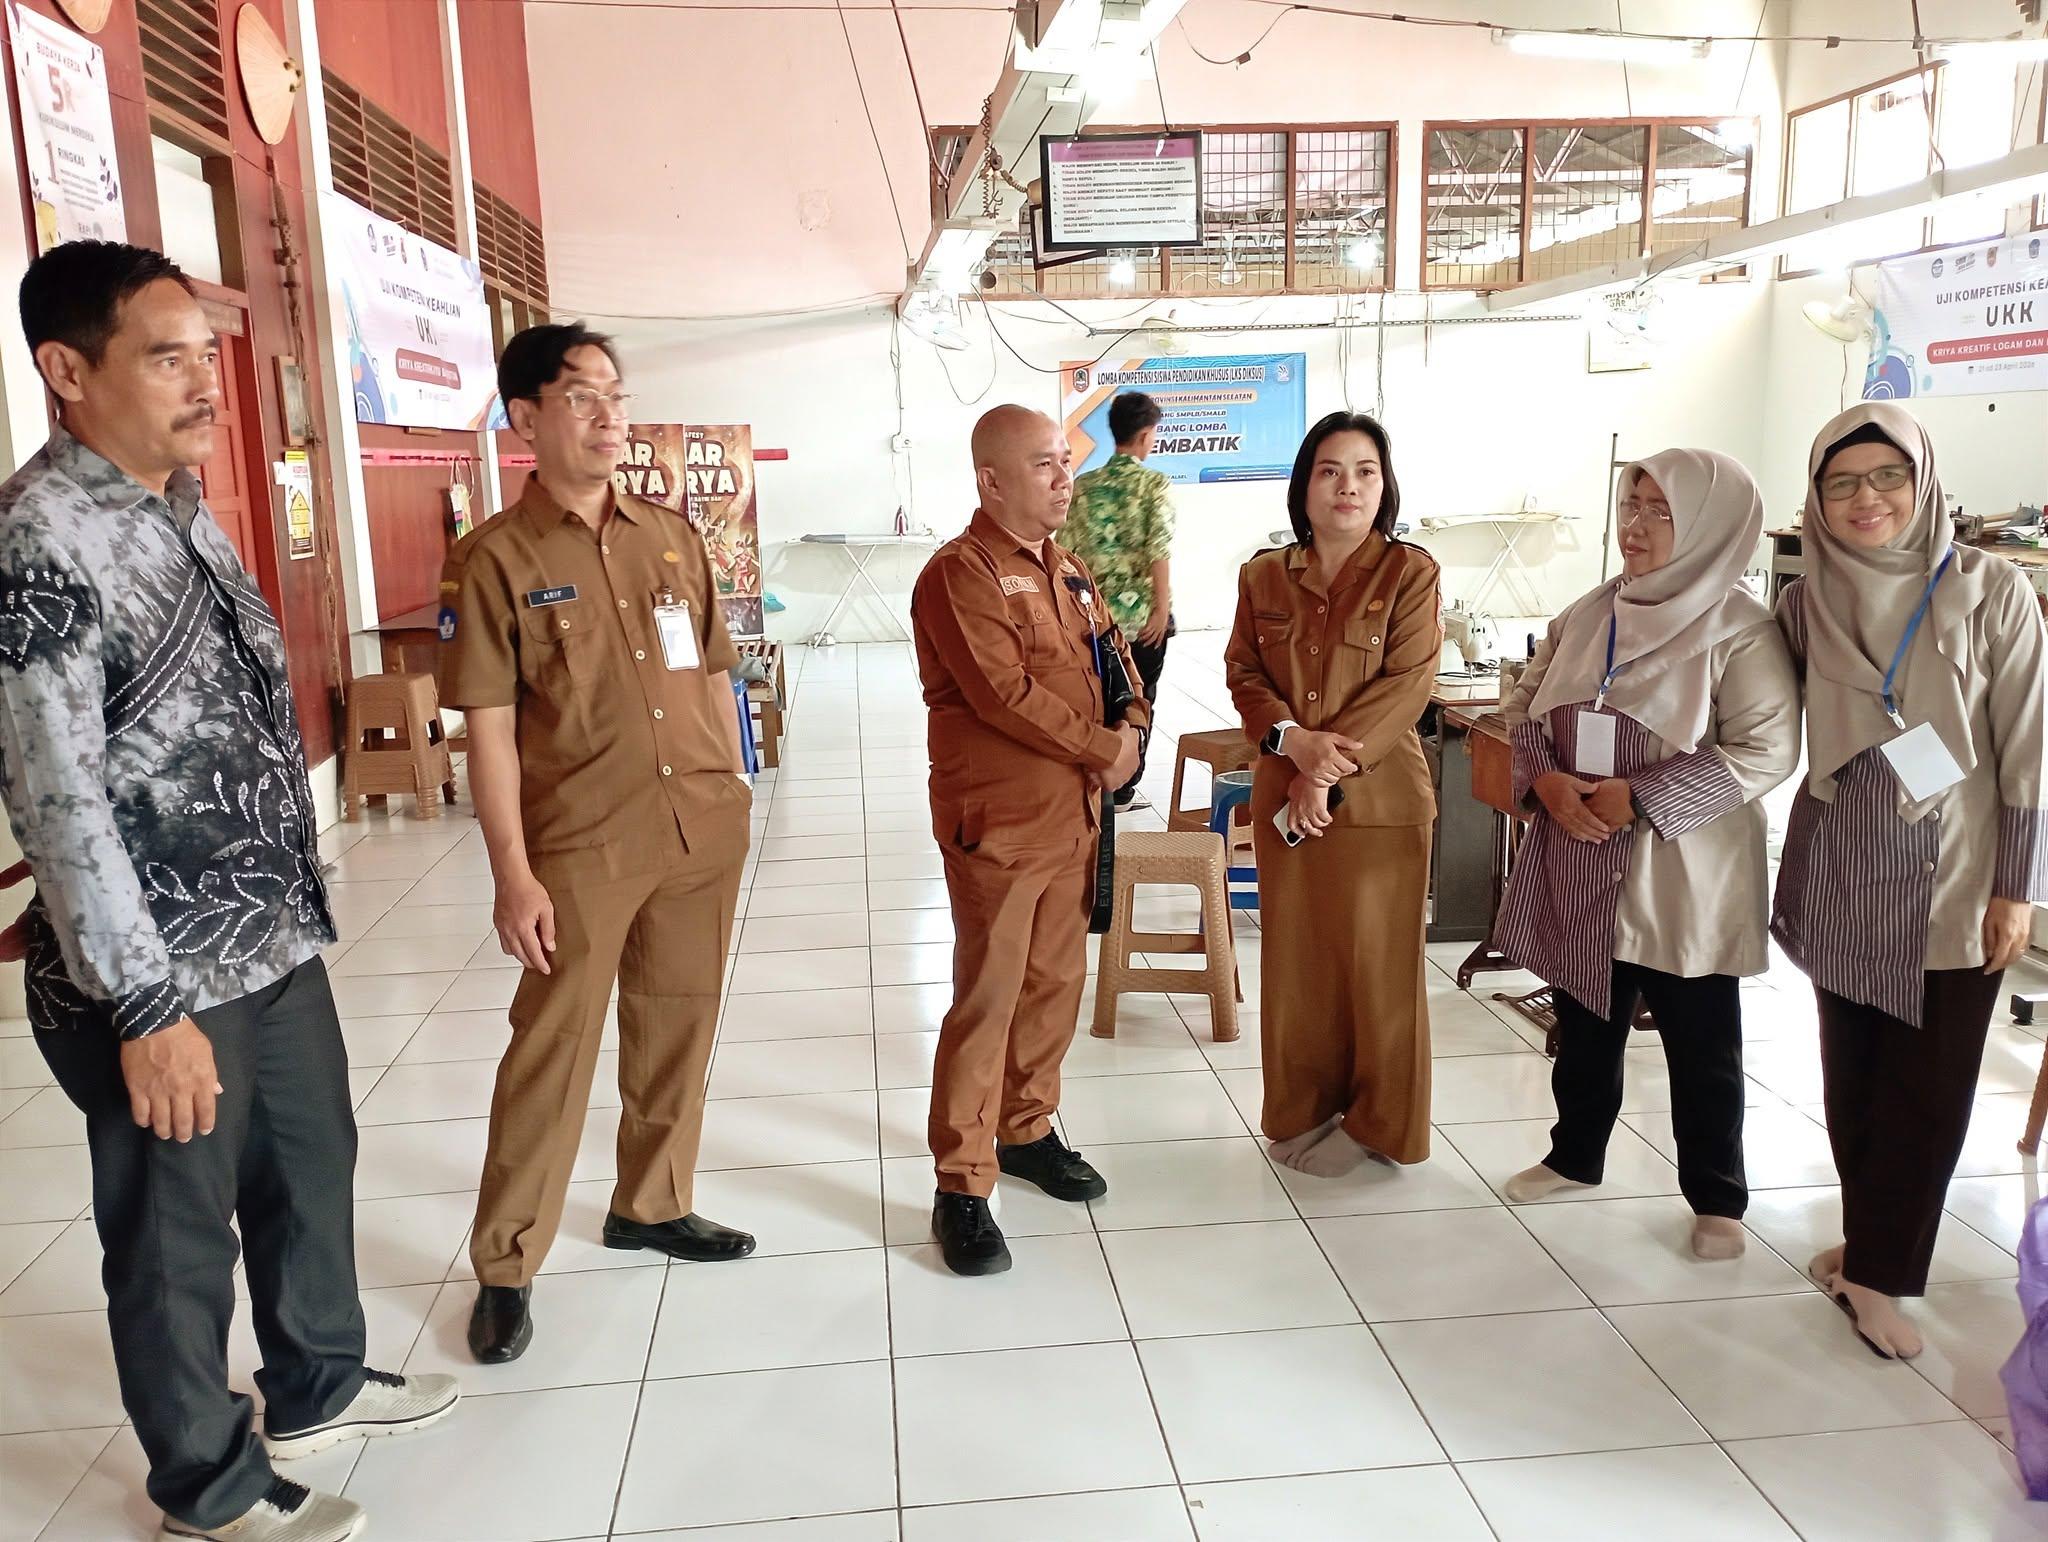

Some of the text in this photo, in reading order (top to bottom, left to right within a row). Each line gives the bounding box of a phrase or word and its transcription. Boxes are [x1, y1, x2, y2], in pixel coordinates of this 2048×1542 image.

[36, 41, 61, 62] BUDAYA
[1936, 292, 1952, 305] UJI
[1955, 281, 2026, 303] KOMPETENSI
[426, 296, 461, 319] KEAHLIAN
[1986, 300, 2034, 328] UKK
[1932, 338, 2044, 357] KRIYA KREATIF LOGAM DAN
[1097, 366, 1264, 386] LOMBA KOMPETENSI SISWA PENDIDIKAN KHUSUS (LKS DIKSUS)
[1178, 393, 1222, 403] KALIMANTAN
[1223, 392, 1253, 401] SELATAN
[1156, 422, 1227, 433] BANG LOMBA
[688, 442, 722, 467] AR
[1151, 435, 1241, 454] EMBATIK
[687, 469, 736, 495] RYA
[543, 590, 562, 600] ARIF
